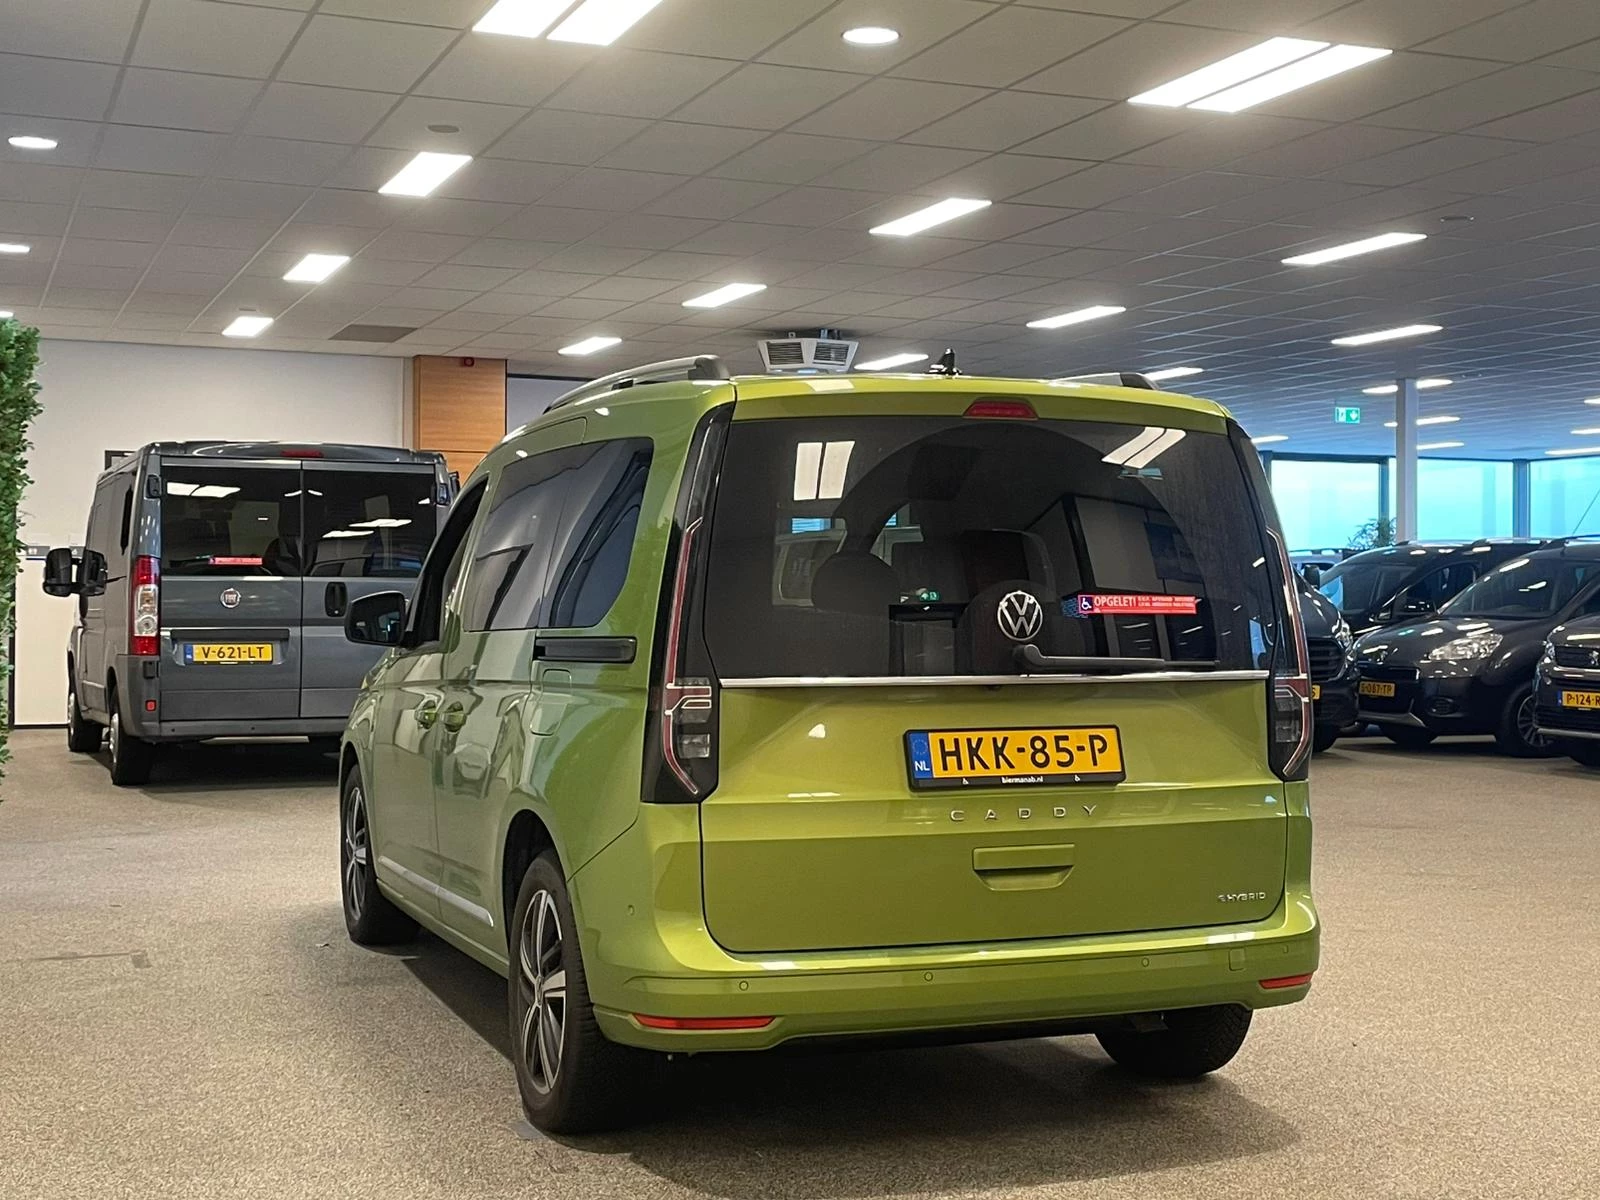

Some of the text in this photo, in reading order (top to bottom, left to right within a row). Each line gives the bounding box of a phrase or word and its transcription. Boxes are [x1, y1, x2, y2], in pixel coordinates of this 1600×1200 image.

[201, 646, 265, 659] V-621-LT
[938, 734, 1108, 771] HKK-85-P
[914, 760, 931, 772] NL
[950, 804, 1097, 822] CADDY
